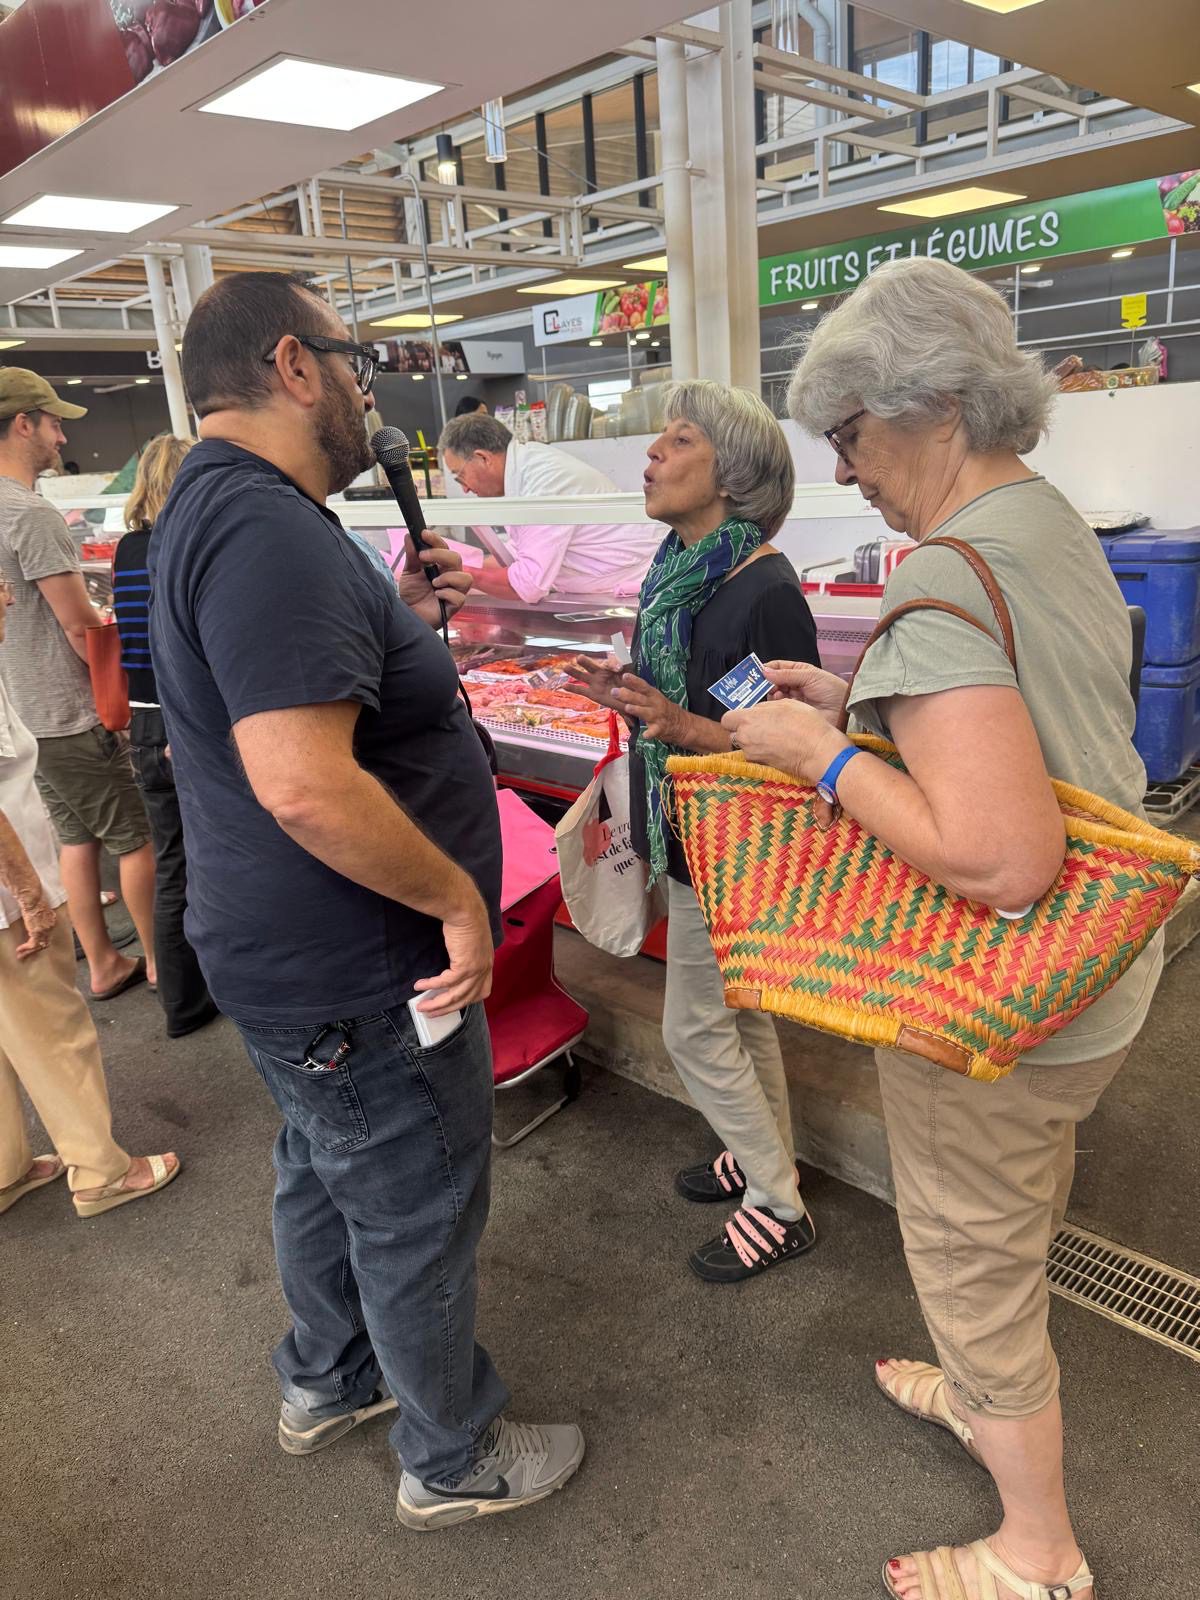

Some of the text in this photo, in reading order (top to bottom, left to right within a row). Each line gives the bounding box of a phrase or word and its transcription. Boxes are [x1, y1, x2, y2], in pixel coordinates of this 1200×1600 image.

[770, 251, 860, 296] FRUITS
[866, 242, 903, 275] ET
[602, 827, 616, 841] Le
[609, 843, 622, 857] de
[613, 857, 635, 876] que
